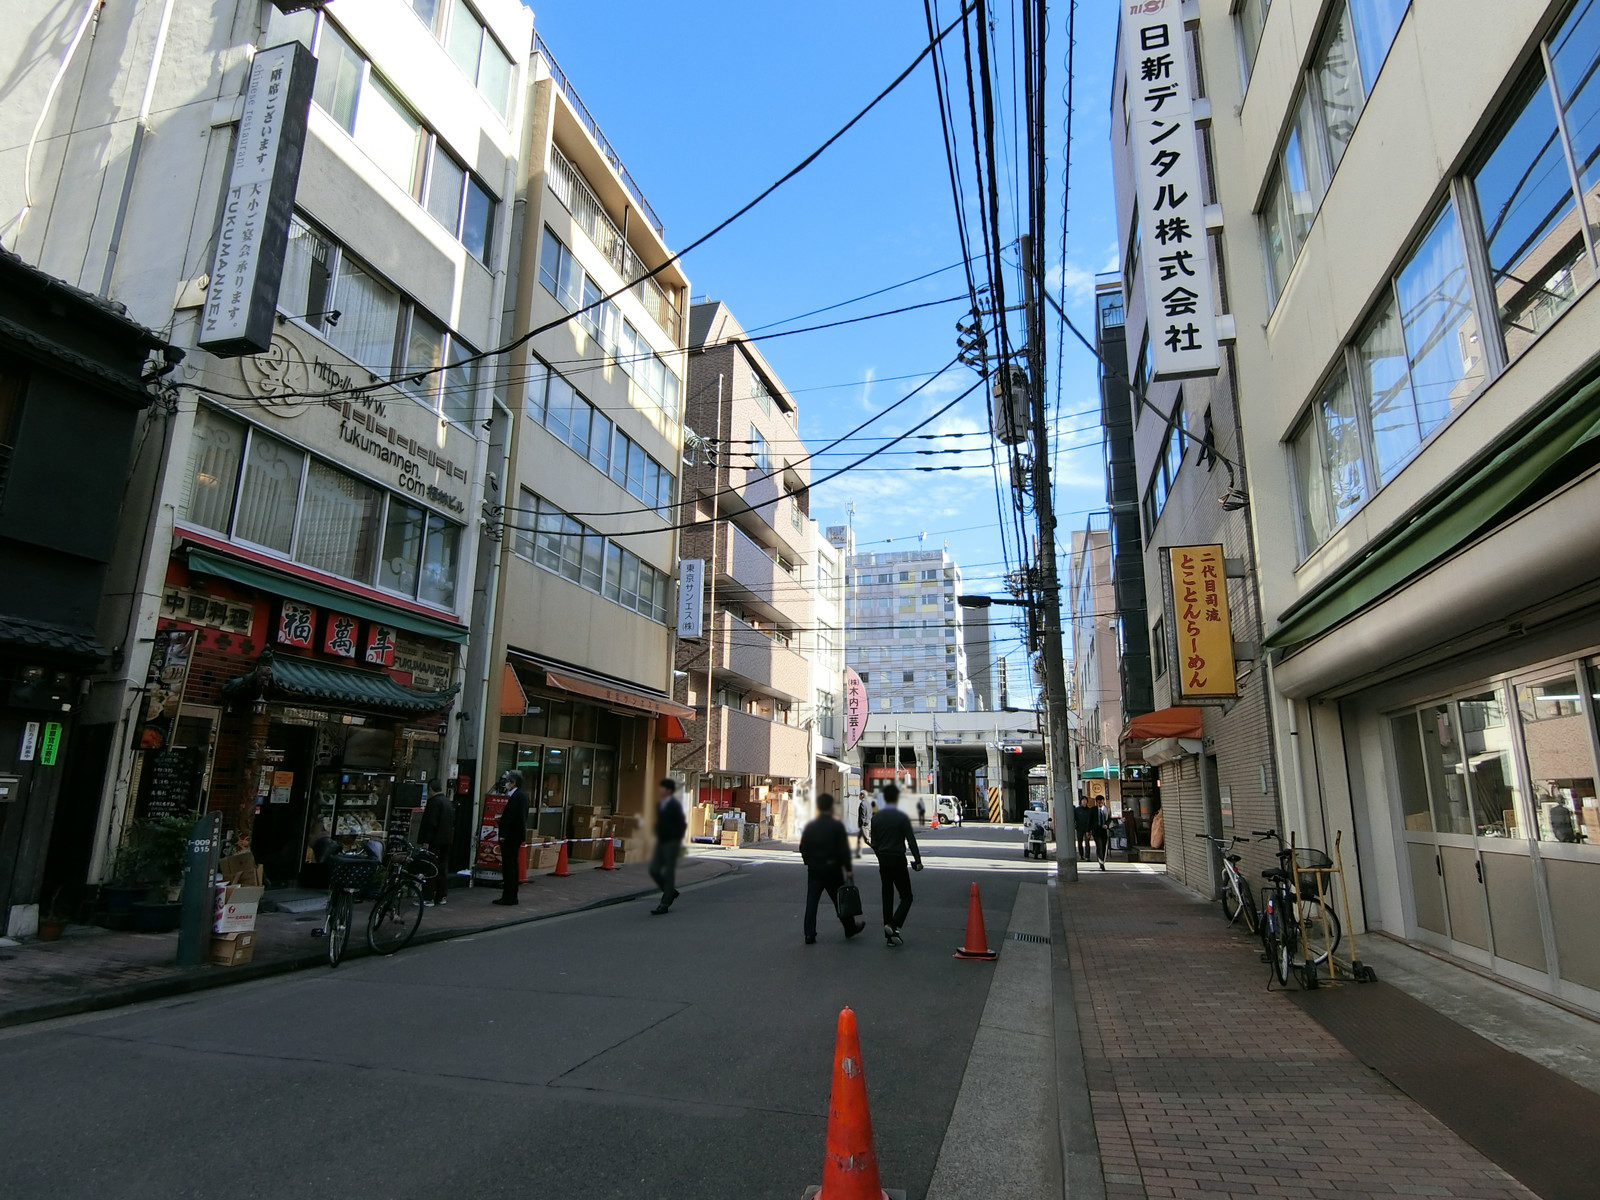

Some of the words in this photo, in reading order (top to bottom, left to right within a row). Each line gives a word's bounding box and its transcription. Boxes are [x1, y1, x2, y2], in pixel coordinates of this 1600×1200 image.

[247, 64, 265, 106] chinese
[1140, 23, 1202, 353] 日新デンタル株式会社
[206, 187, 242, 332] FUKUMANNEN
[339, 420, 422, 480] fukumannen.
[398, 473, 426, 497] com
[1200, 552, 1221, 622] 二代目司流
[1180, 554, 1208, 688] とことんらーめん
[394, 656, 450, 678] FUKUMANNEN
